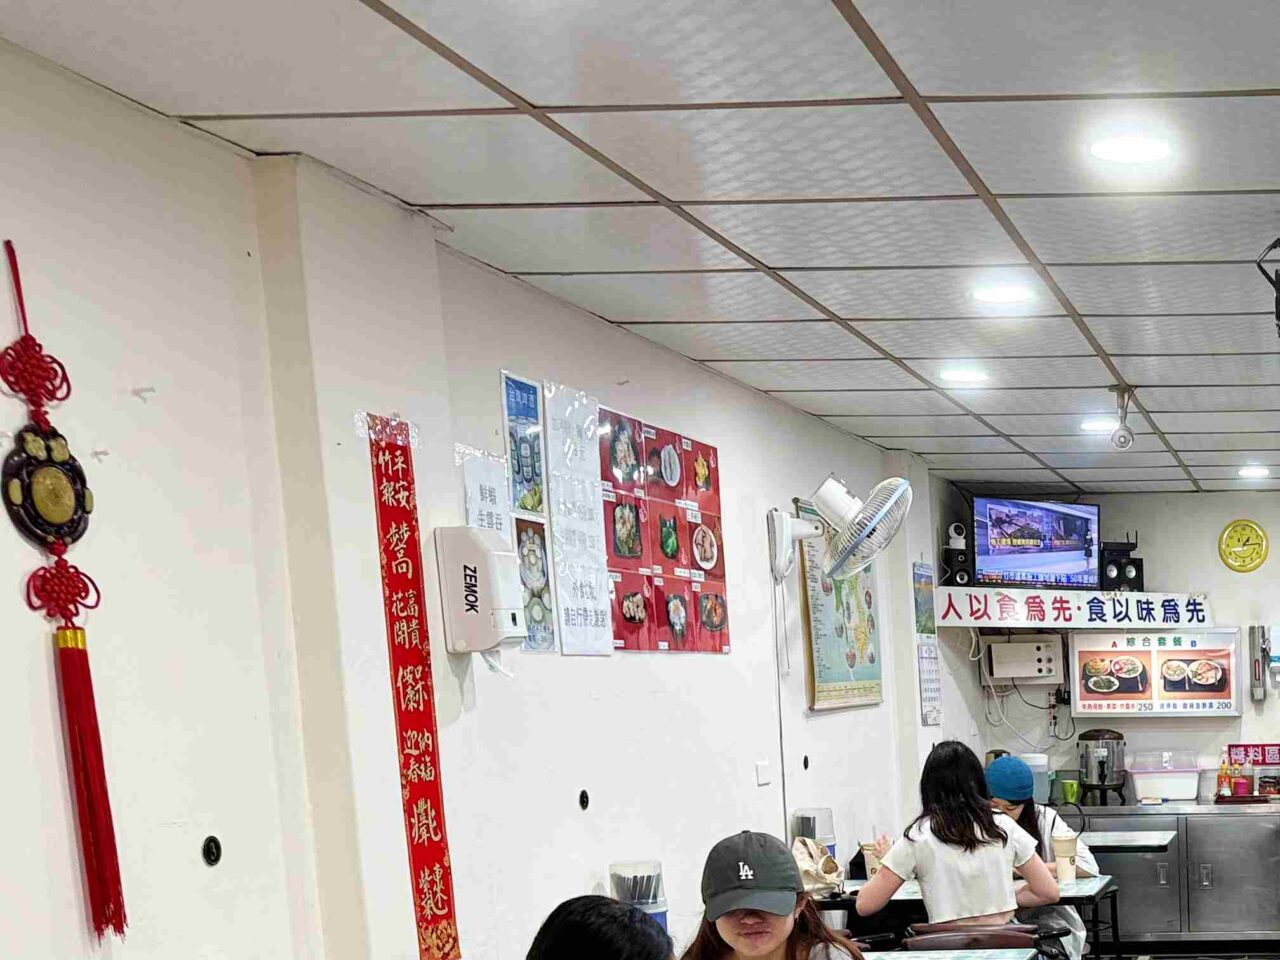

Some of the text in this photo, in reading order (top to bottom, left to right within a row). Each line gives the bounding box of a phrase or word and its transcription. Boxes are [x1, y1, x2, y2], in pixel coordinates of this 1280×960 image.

[463, 564, 479, 614] ZEMOK
[1190, 640, 1197, 648] B
[1137, 702, 1154, 712] 250
[1216, 701, 1232, 710] 200
[738, 861, 754, 880] LA
